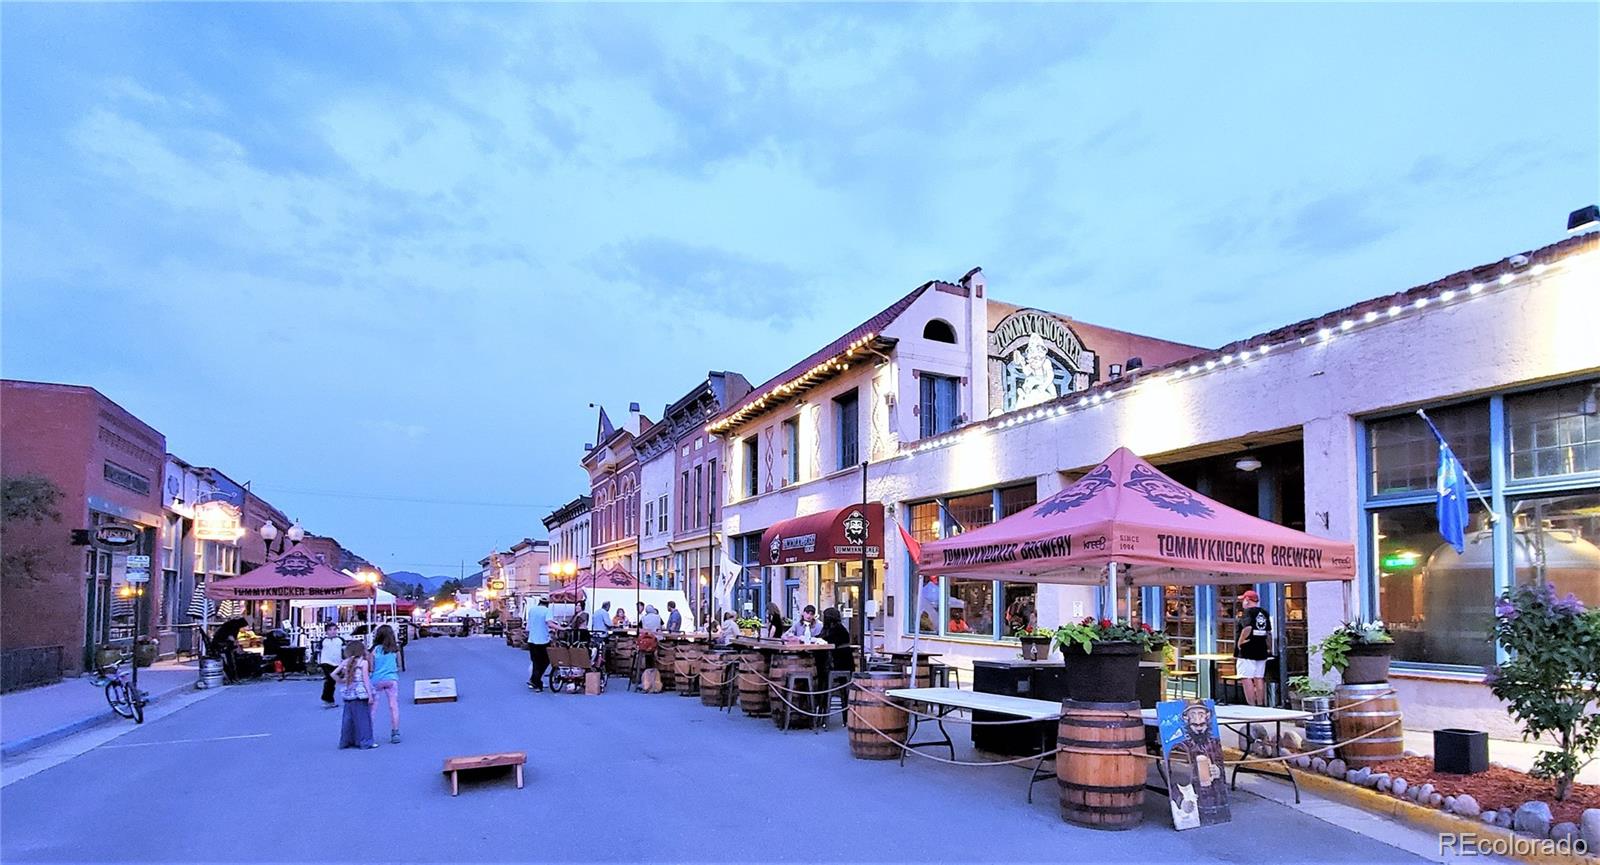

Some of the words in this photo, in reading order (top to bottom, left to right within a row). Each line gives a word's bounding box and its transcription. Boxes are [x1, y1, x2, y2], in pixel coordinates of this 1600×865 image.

[993, 313, 1081, 364] TOMMYKNOCKER
[942, 543, 1018, 567] TOMMYKNOCKER
[1020, 535, 1072, 560] BREWERY
[1157, 534, 1265, 565] TOMMYKNOCKER
[1271, 545, 1323, 569] BREWERY
[233, 587, 305, 597] TOMMYKNOCKER
[308, 587, 346, 596] BREWERY
